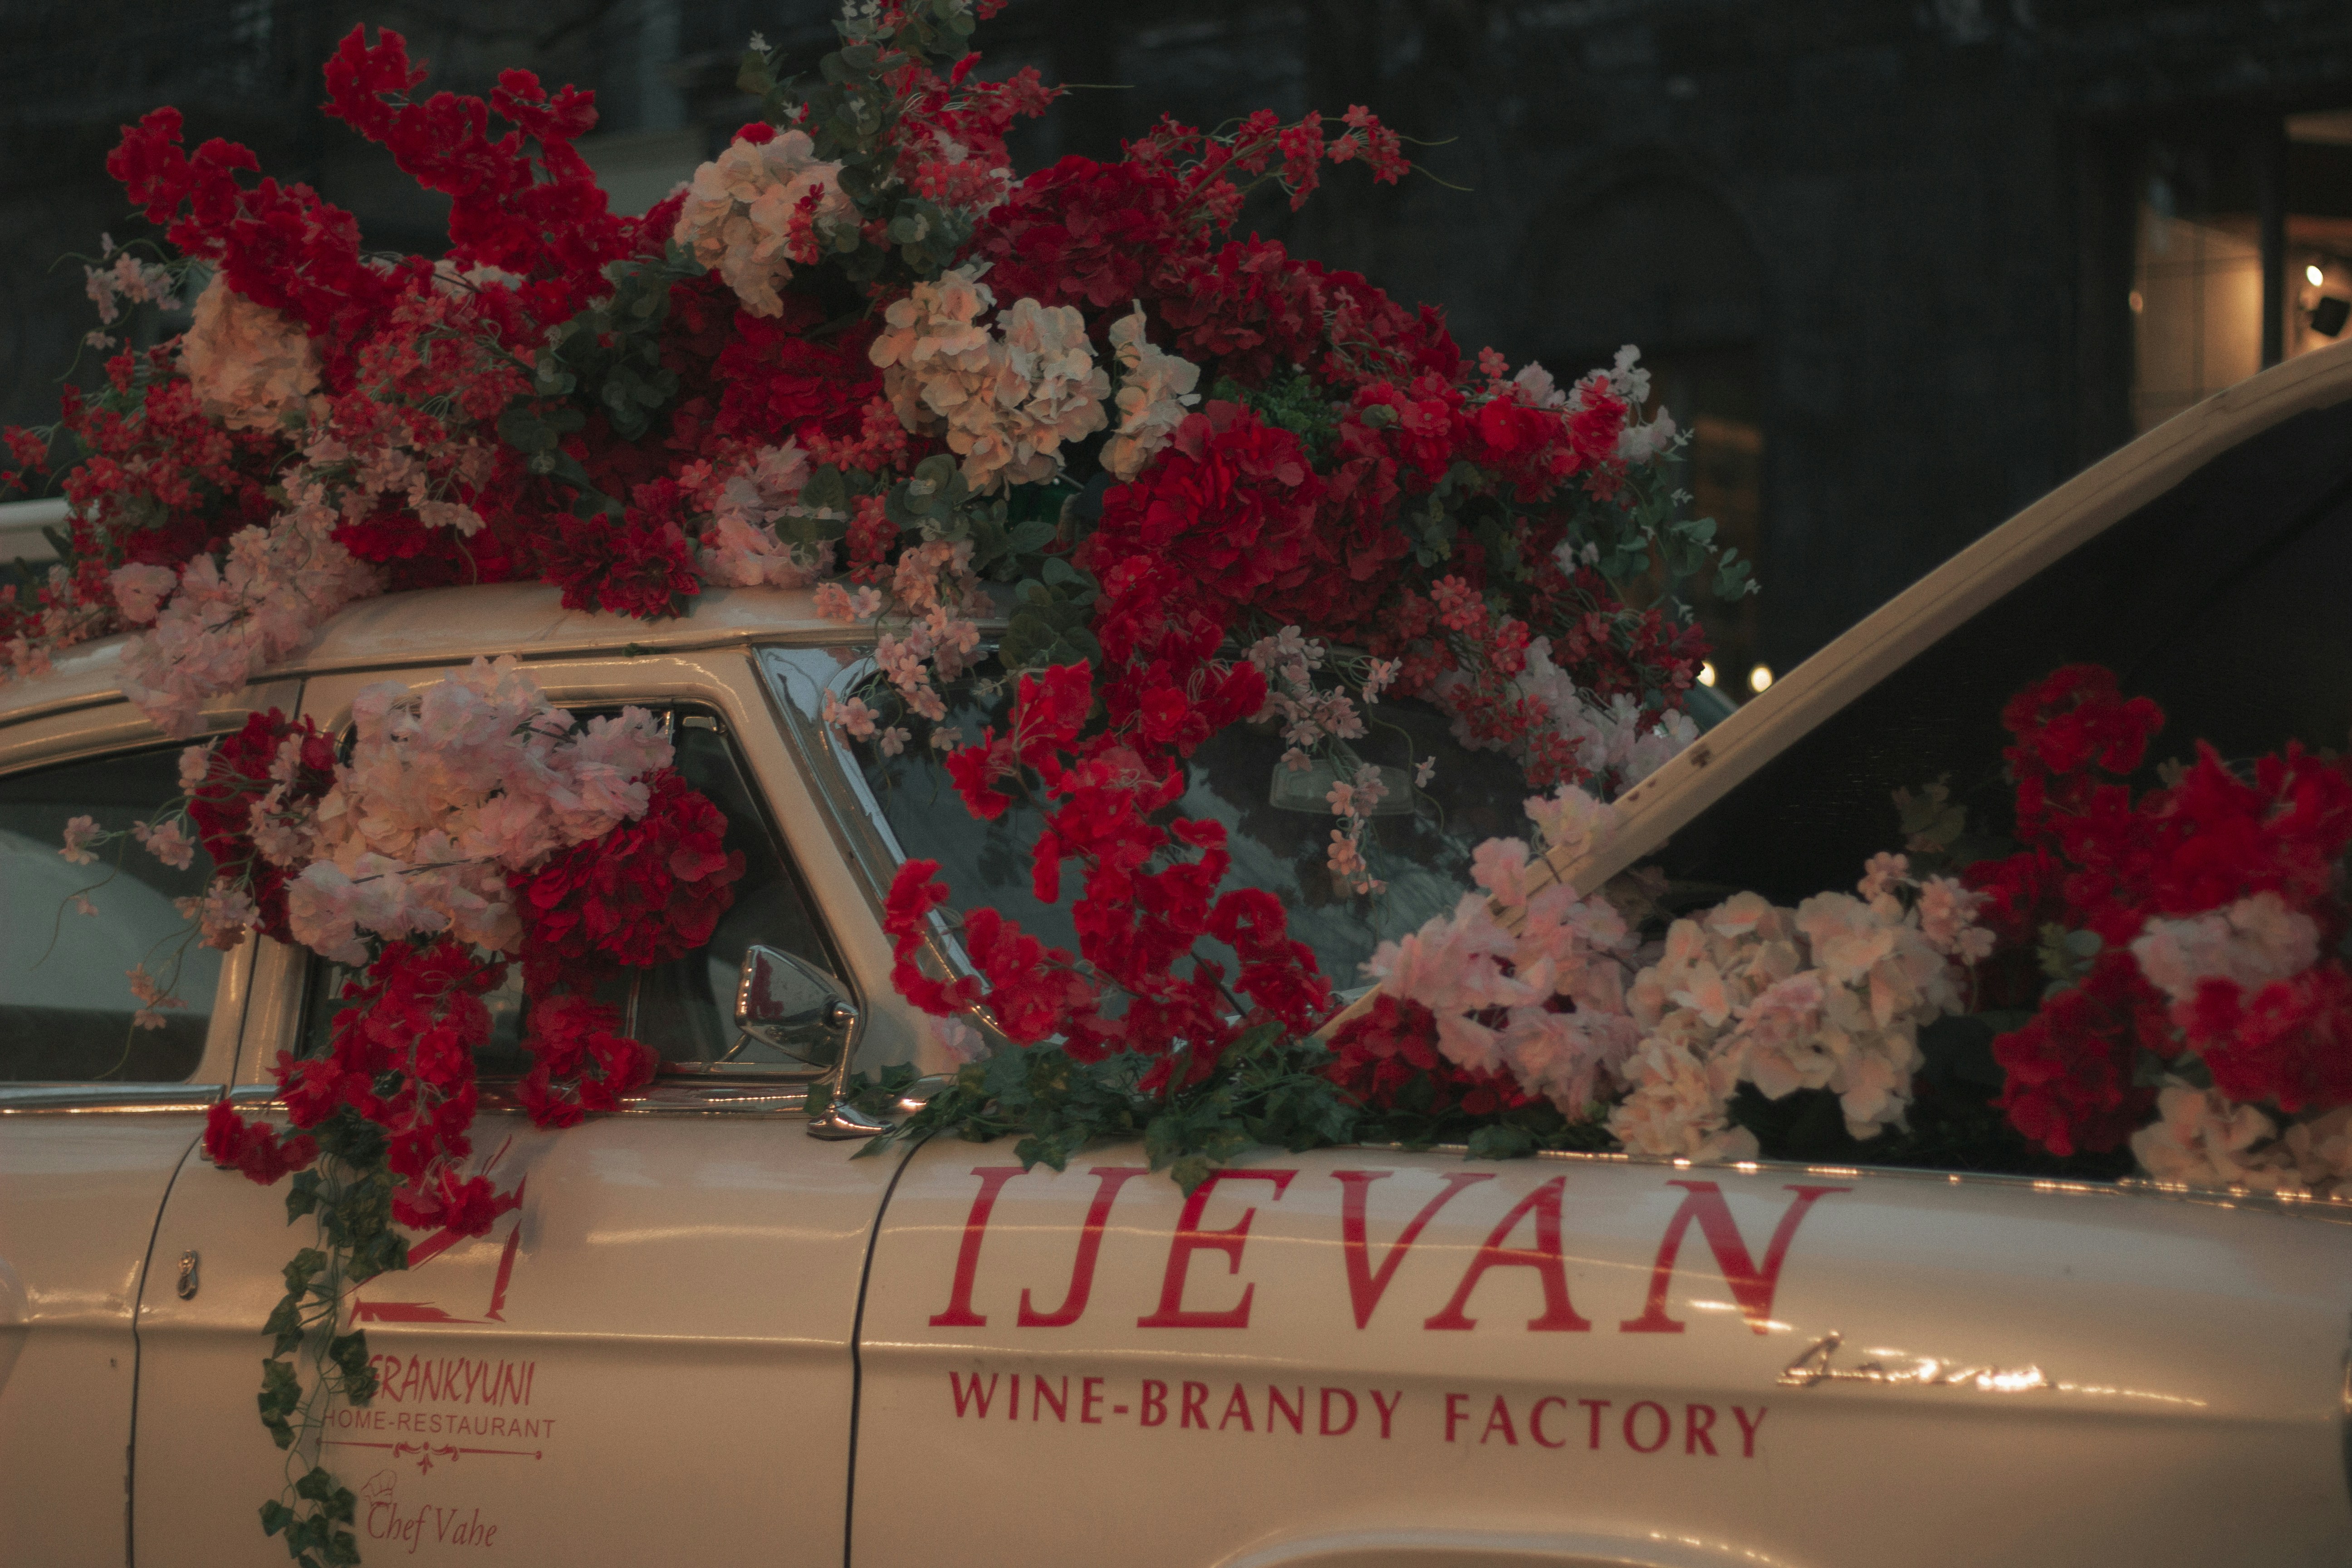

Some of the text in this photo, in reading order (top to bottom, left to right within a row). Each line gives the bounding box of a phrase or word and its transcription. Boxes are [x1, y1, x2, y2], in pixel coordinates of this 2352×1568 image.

[929, 1166, 1852, 1334] IJEVAN
[324, 1409, 556, 1438] HOME-RESTAURANT
[949, 1371, 1767, 1458] WINE-BRANDY FACTORY
[367, 1502, 498, 1554] Chef Vahe
